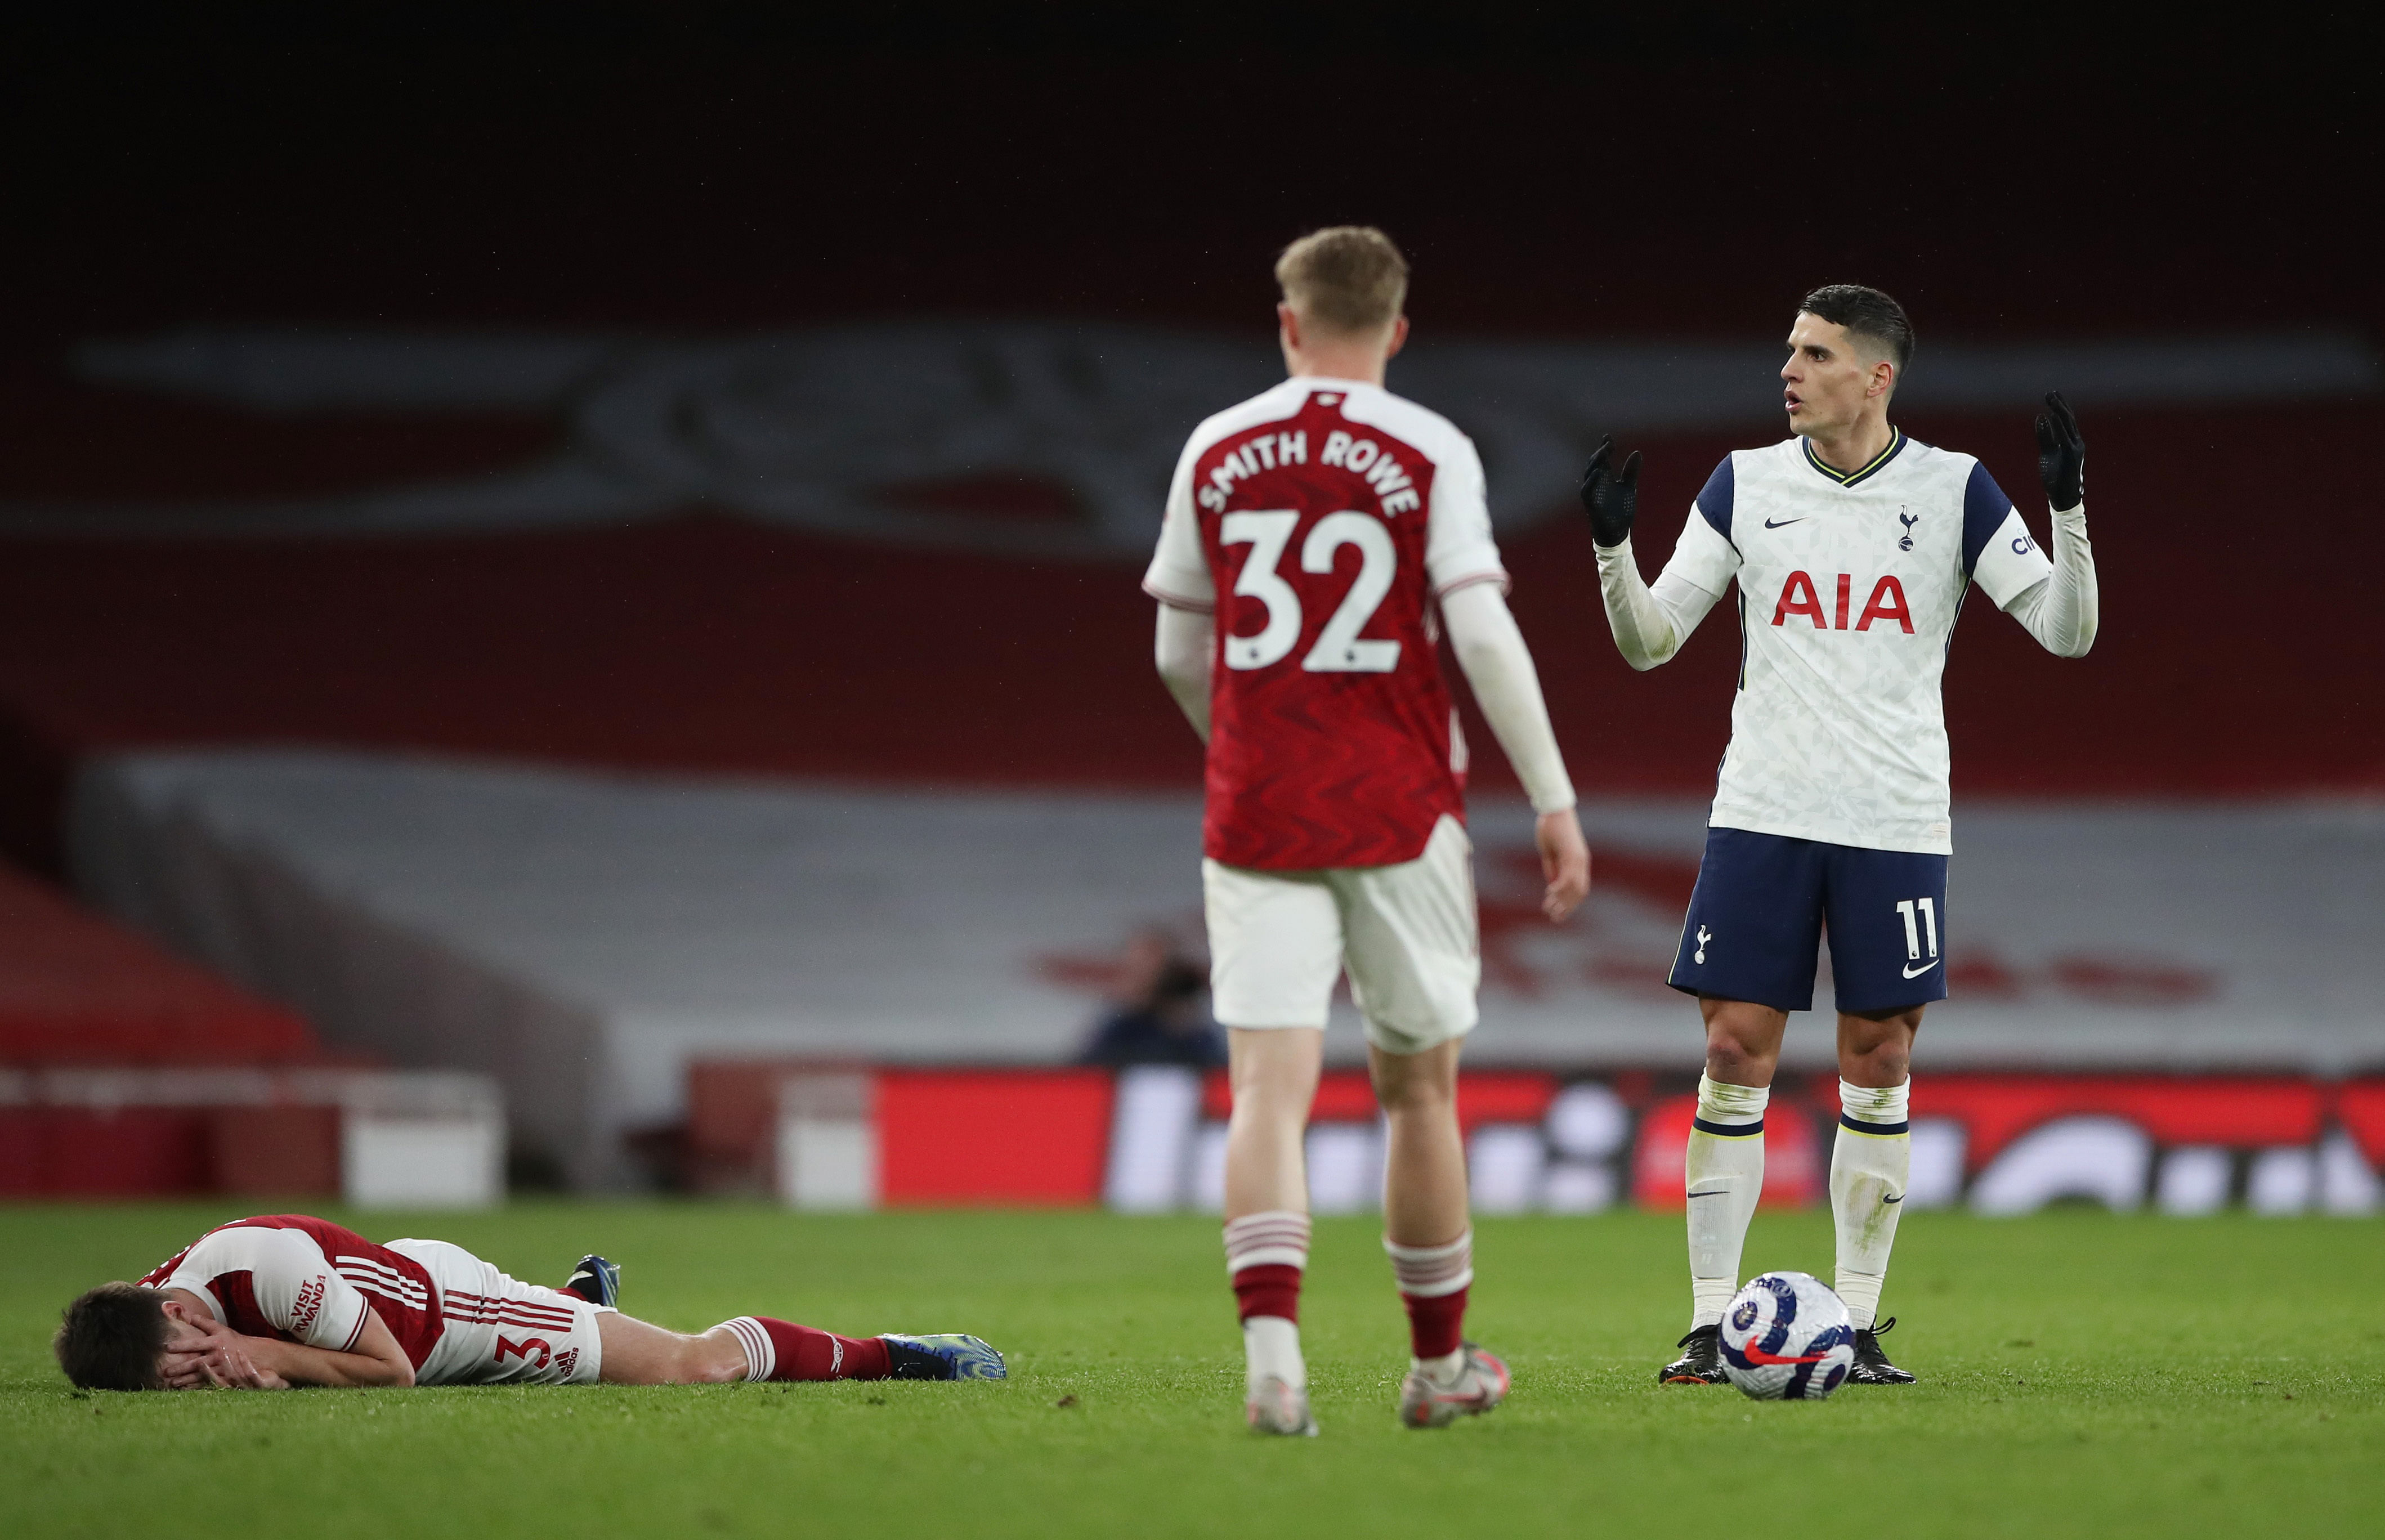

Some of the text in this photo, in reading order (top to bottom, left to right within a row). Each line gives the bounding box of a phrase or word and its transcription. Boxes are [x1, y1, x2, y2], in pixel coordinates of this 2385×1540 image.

[1199, 430, 1421, 518] SMITH ROWE
[1219, 509, 1400, 673] 32
[1771, 570, 1915, 634] AIA
[1896, 897, 1937, 960] 11
[290, 1279, 314, 1316] VISIT
[293, 1275, 326, 1332] RWANDA
[493, 1334, 551, 1369] 3
[565, 1347, 579, 1377] adidas
